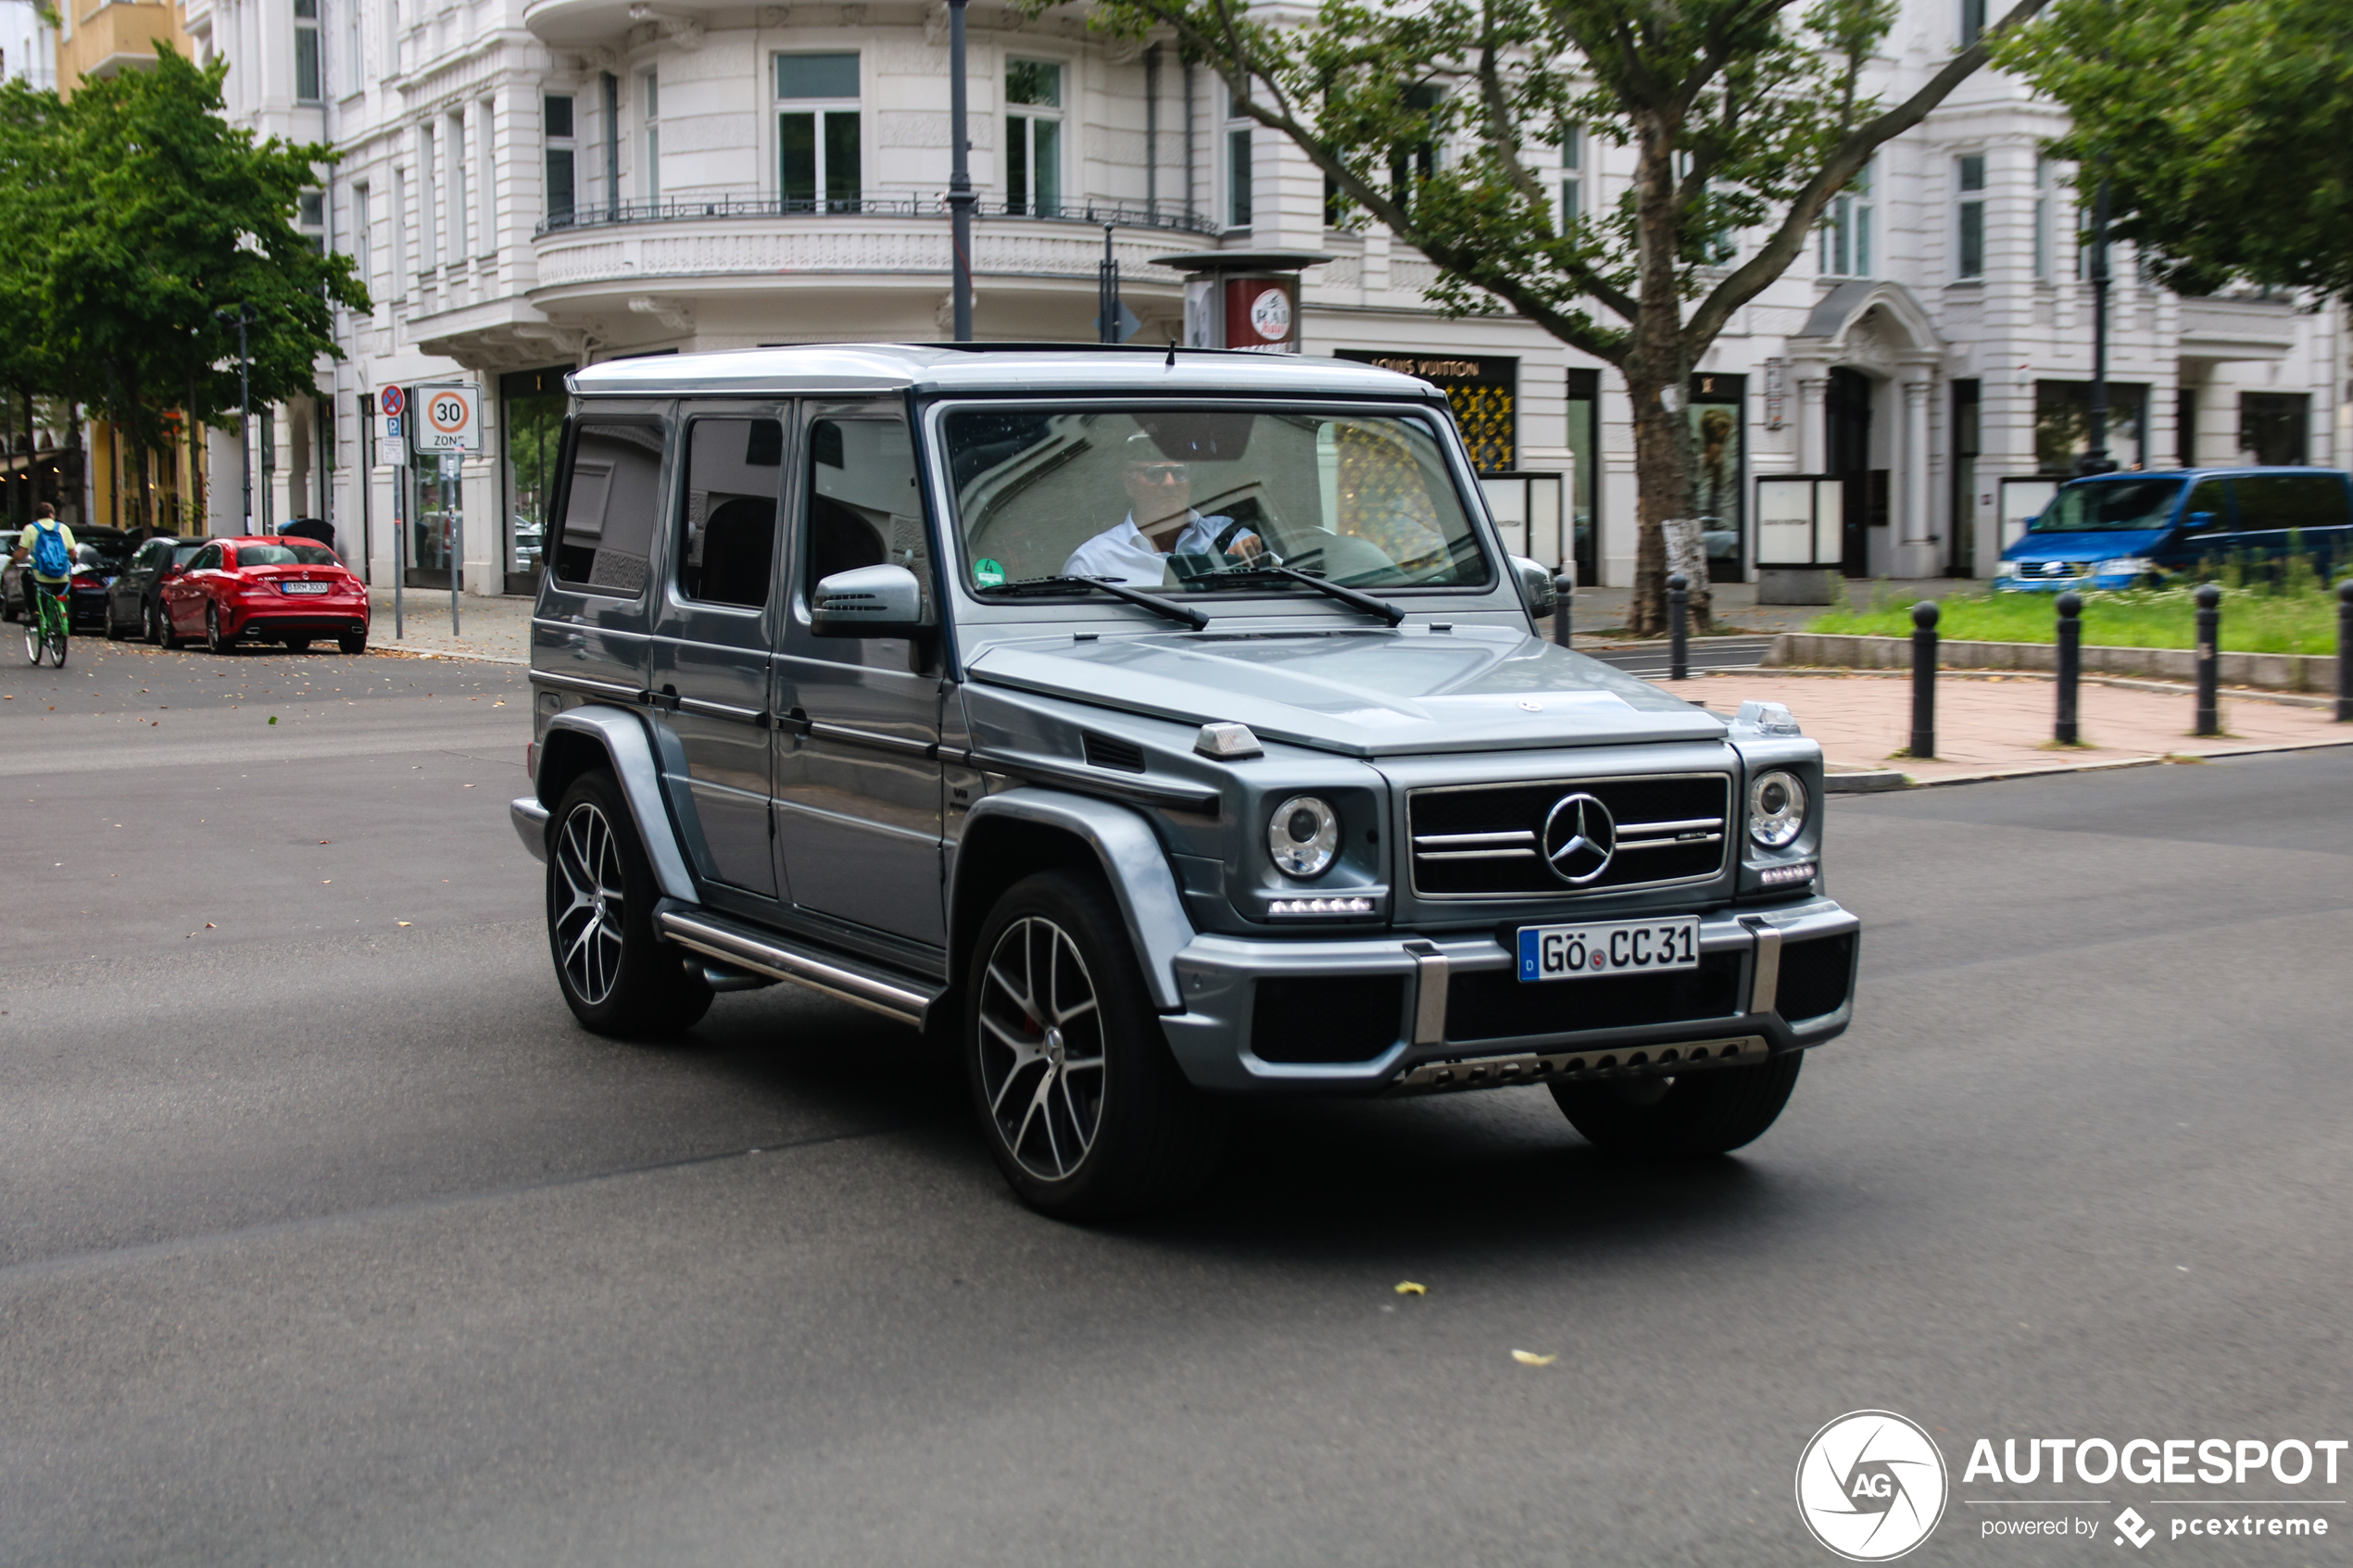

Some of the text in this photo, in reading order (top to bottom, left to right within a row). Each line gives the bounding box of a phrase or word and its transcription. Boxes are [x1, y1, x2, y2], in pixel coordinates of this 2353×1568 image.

[1417, 358, 1479, 377] VUITTON
[436, 403, 460, 421] 30
[985, 559, 993, 573] 4
[1543, 933, 1586, 972] GÖ
[1527, 960, 1533, 971] D
